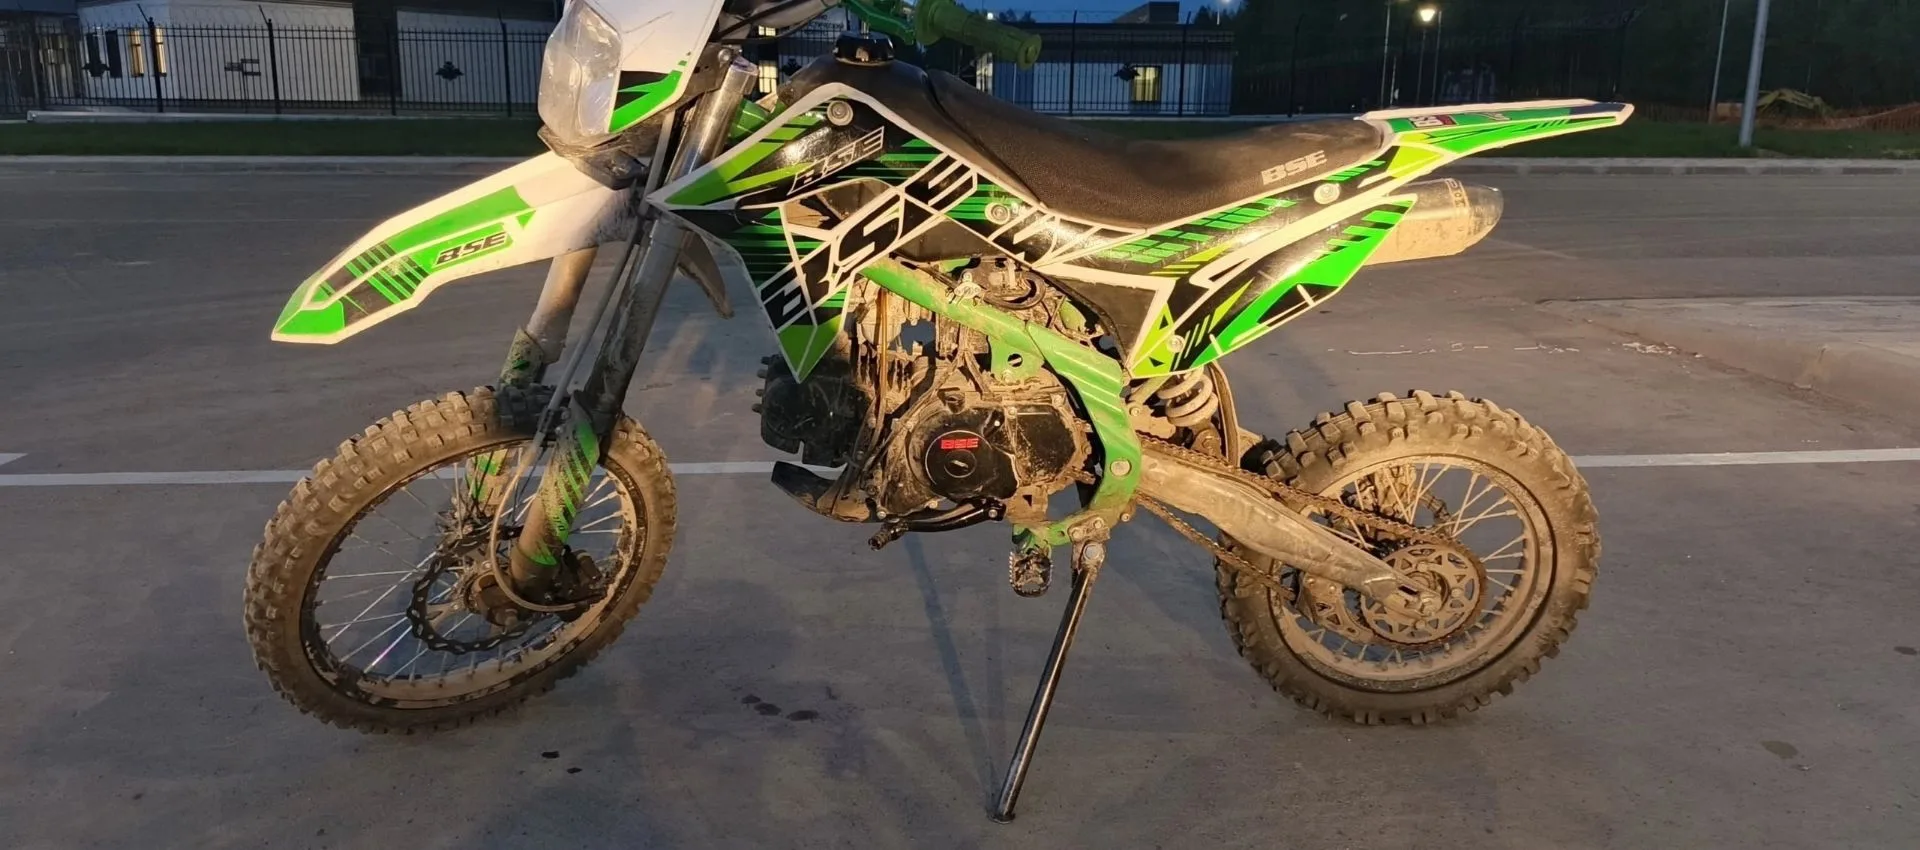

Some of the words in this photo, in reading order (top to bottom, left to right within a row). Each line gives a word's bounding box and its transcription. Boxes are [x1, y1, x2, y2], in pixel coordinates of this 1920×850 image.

[787, 126, 885, 196] BSE
[1261, 150, 1328, 185] BSE
[434, 231, 507, 265] BSE
[940, 437, 979, 450] BSE
